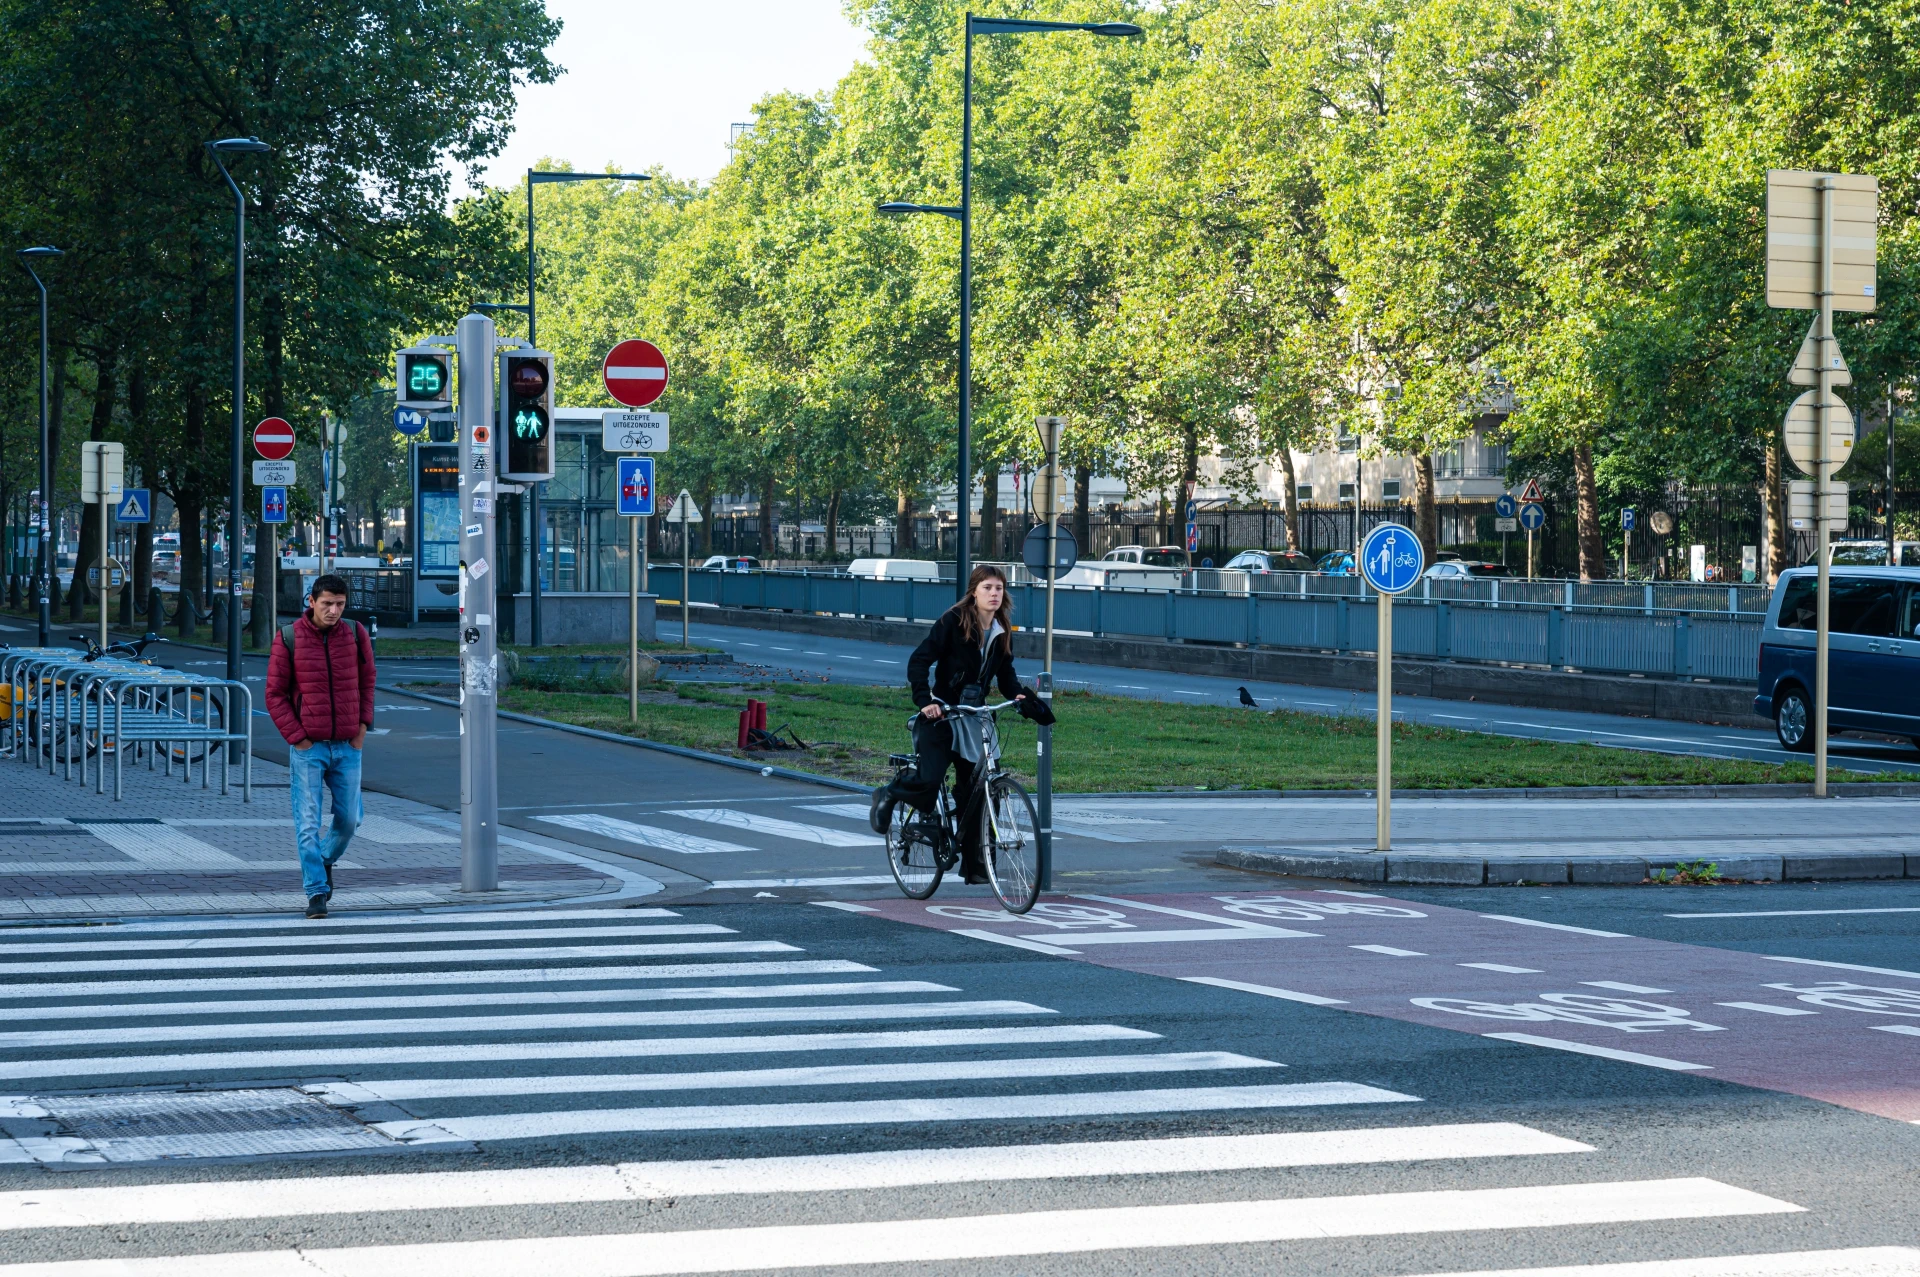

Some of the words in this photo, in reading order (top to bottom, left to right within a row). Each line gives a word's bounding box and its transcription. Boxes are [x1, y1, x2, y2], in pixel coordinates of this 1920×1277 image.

[411, 366, 439, 390] 25
[398, 411, 422, 425] M
[612, 421, 660, 429] UITGEZONDERD
[1623, 511, 1633, 527] P
